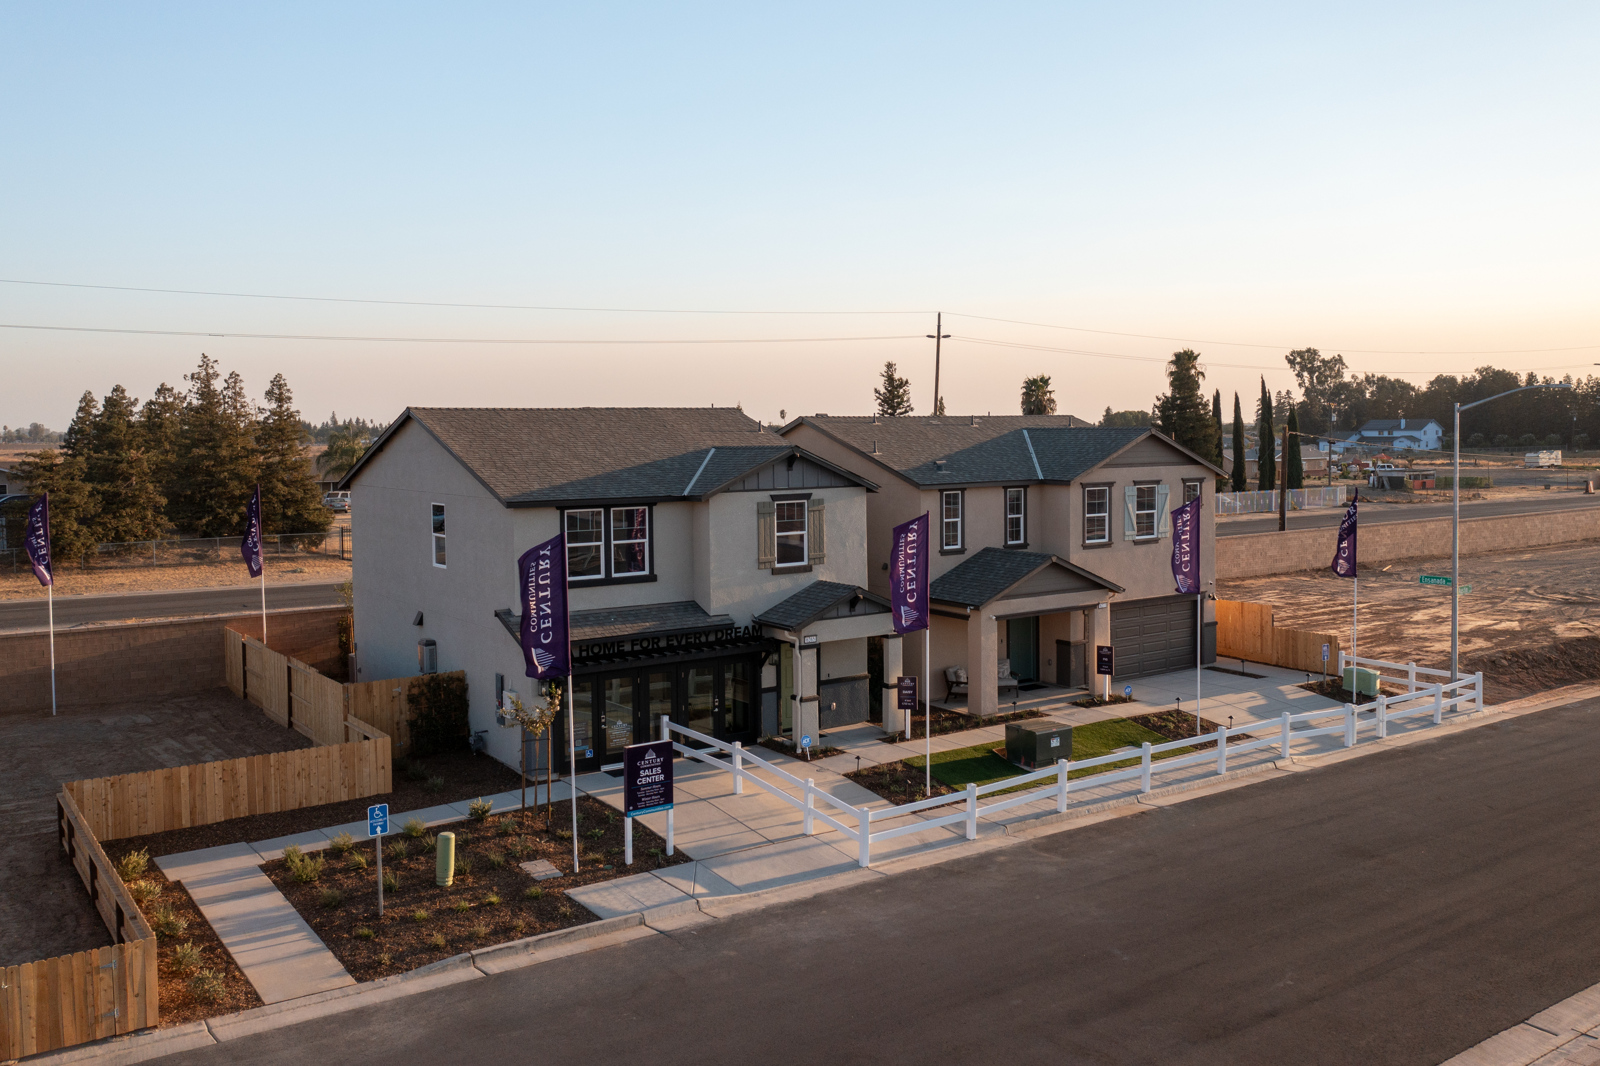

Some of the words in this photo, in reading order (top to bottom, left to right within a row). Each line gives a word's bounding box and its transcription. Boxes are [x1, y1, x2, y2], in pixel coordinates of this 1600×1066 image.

[578, 640, 625, 657] HOME
[630, 637, 660, 651] FOR
[666, 631, 711, 647] EVERY
[714, 624, 763, 640] DREAM
[636, 757, 664, 766] CENTURY
[640, 766, 662, 777] SALES
[636, 774, 665, 785] CENTER
